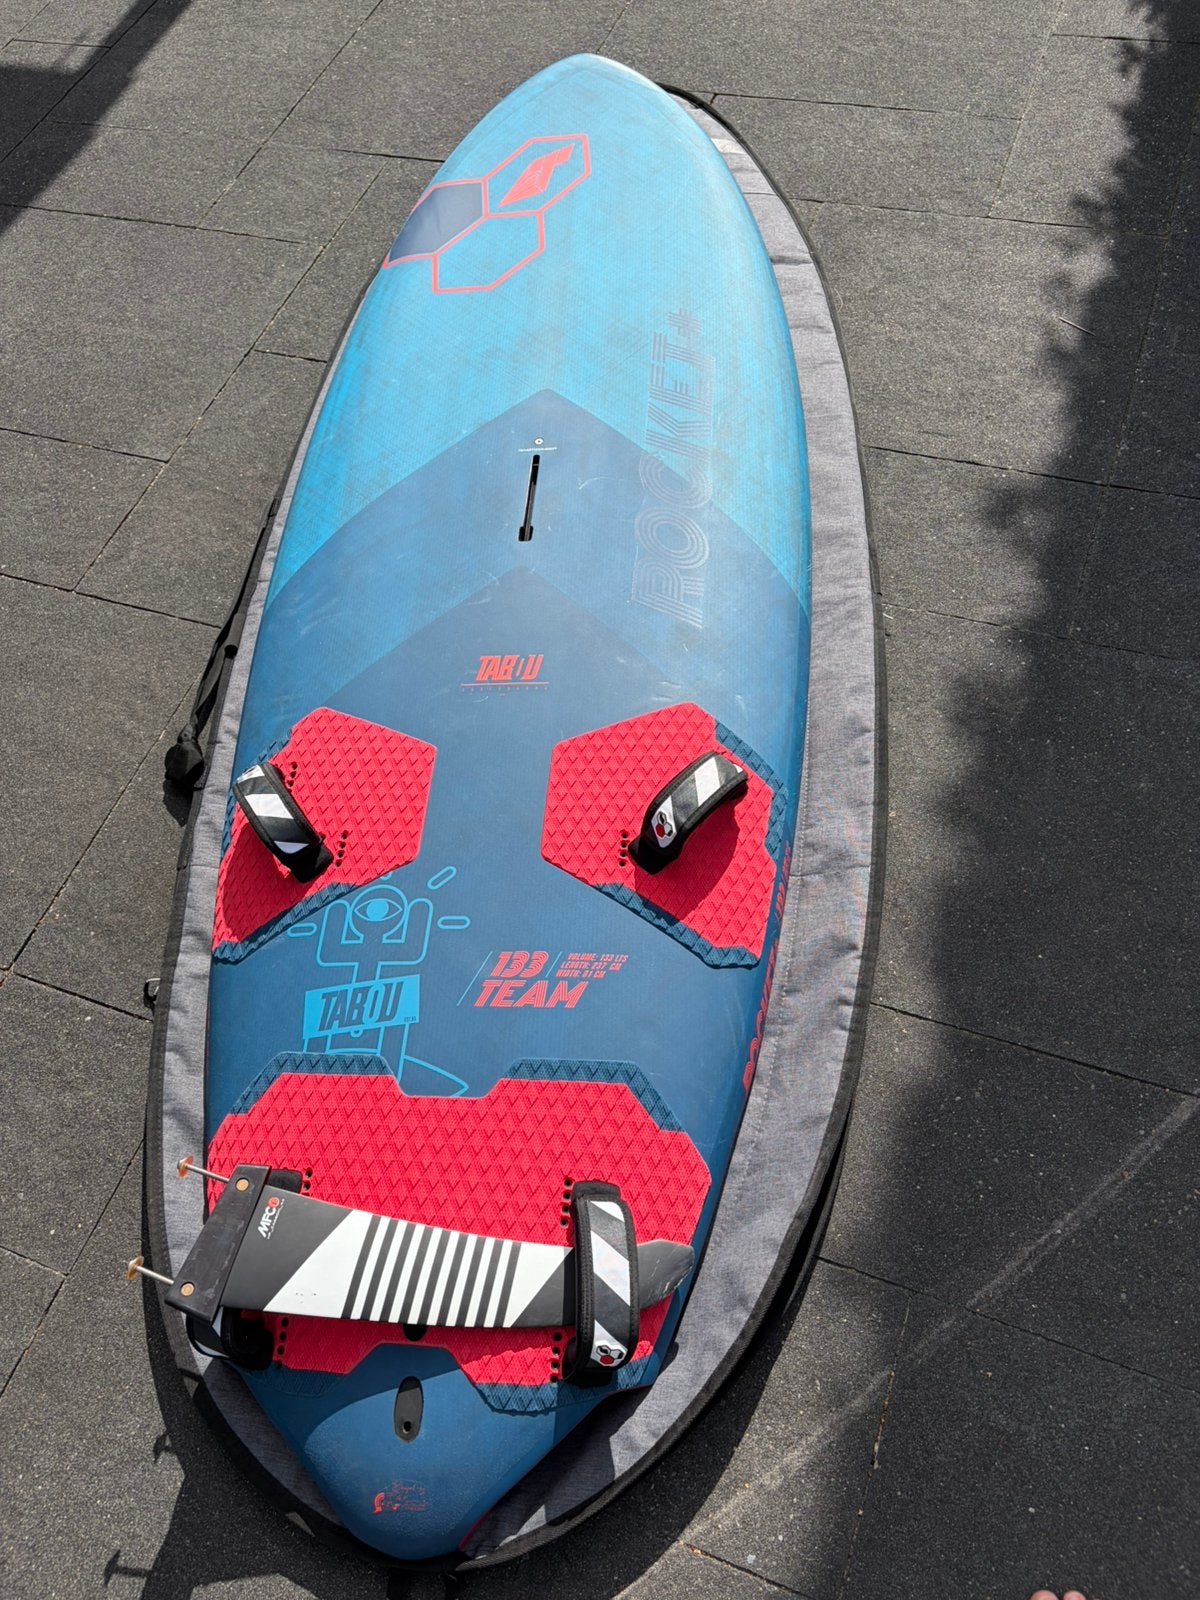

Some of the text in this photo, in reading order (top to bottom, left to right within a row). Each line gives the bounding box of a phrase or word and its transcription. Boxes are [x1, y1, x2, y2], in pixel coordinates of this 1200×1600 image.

[489, 950, 550, 979] 133
[318, 981, 405, 1033] TABOU
[473, 979, 589, 1009] TEAM
[257, 1206, 277, 1238] MFC
